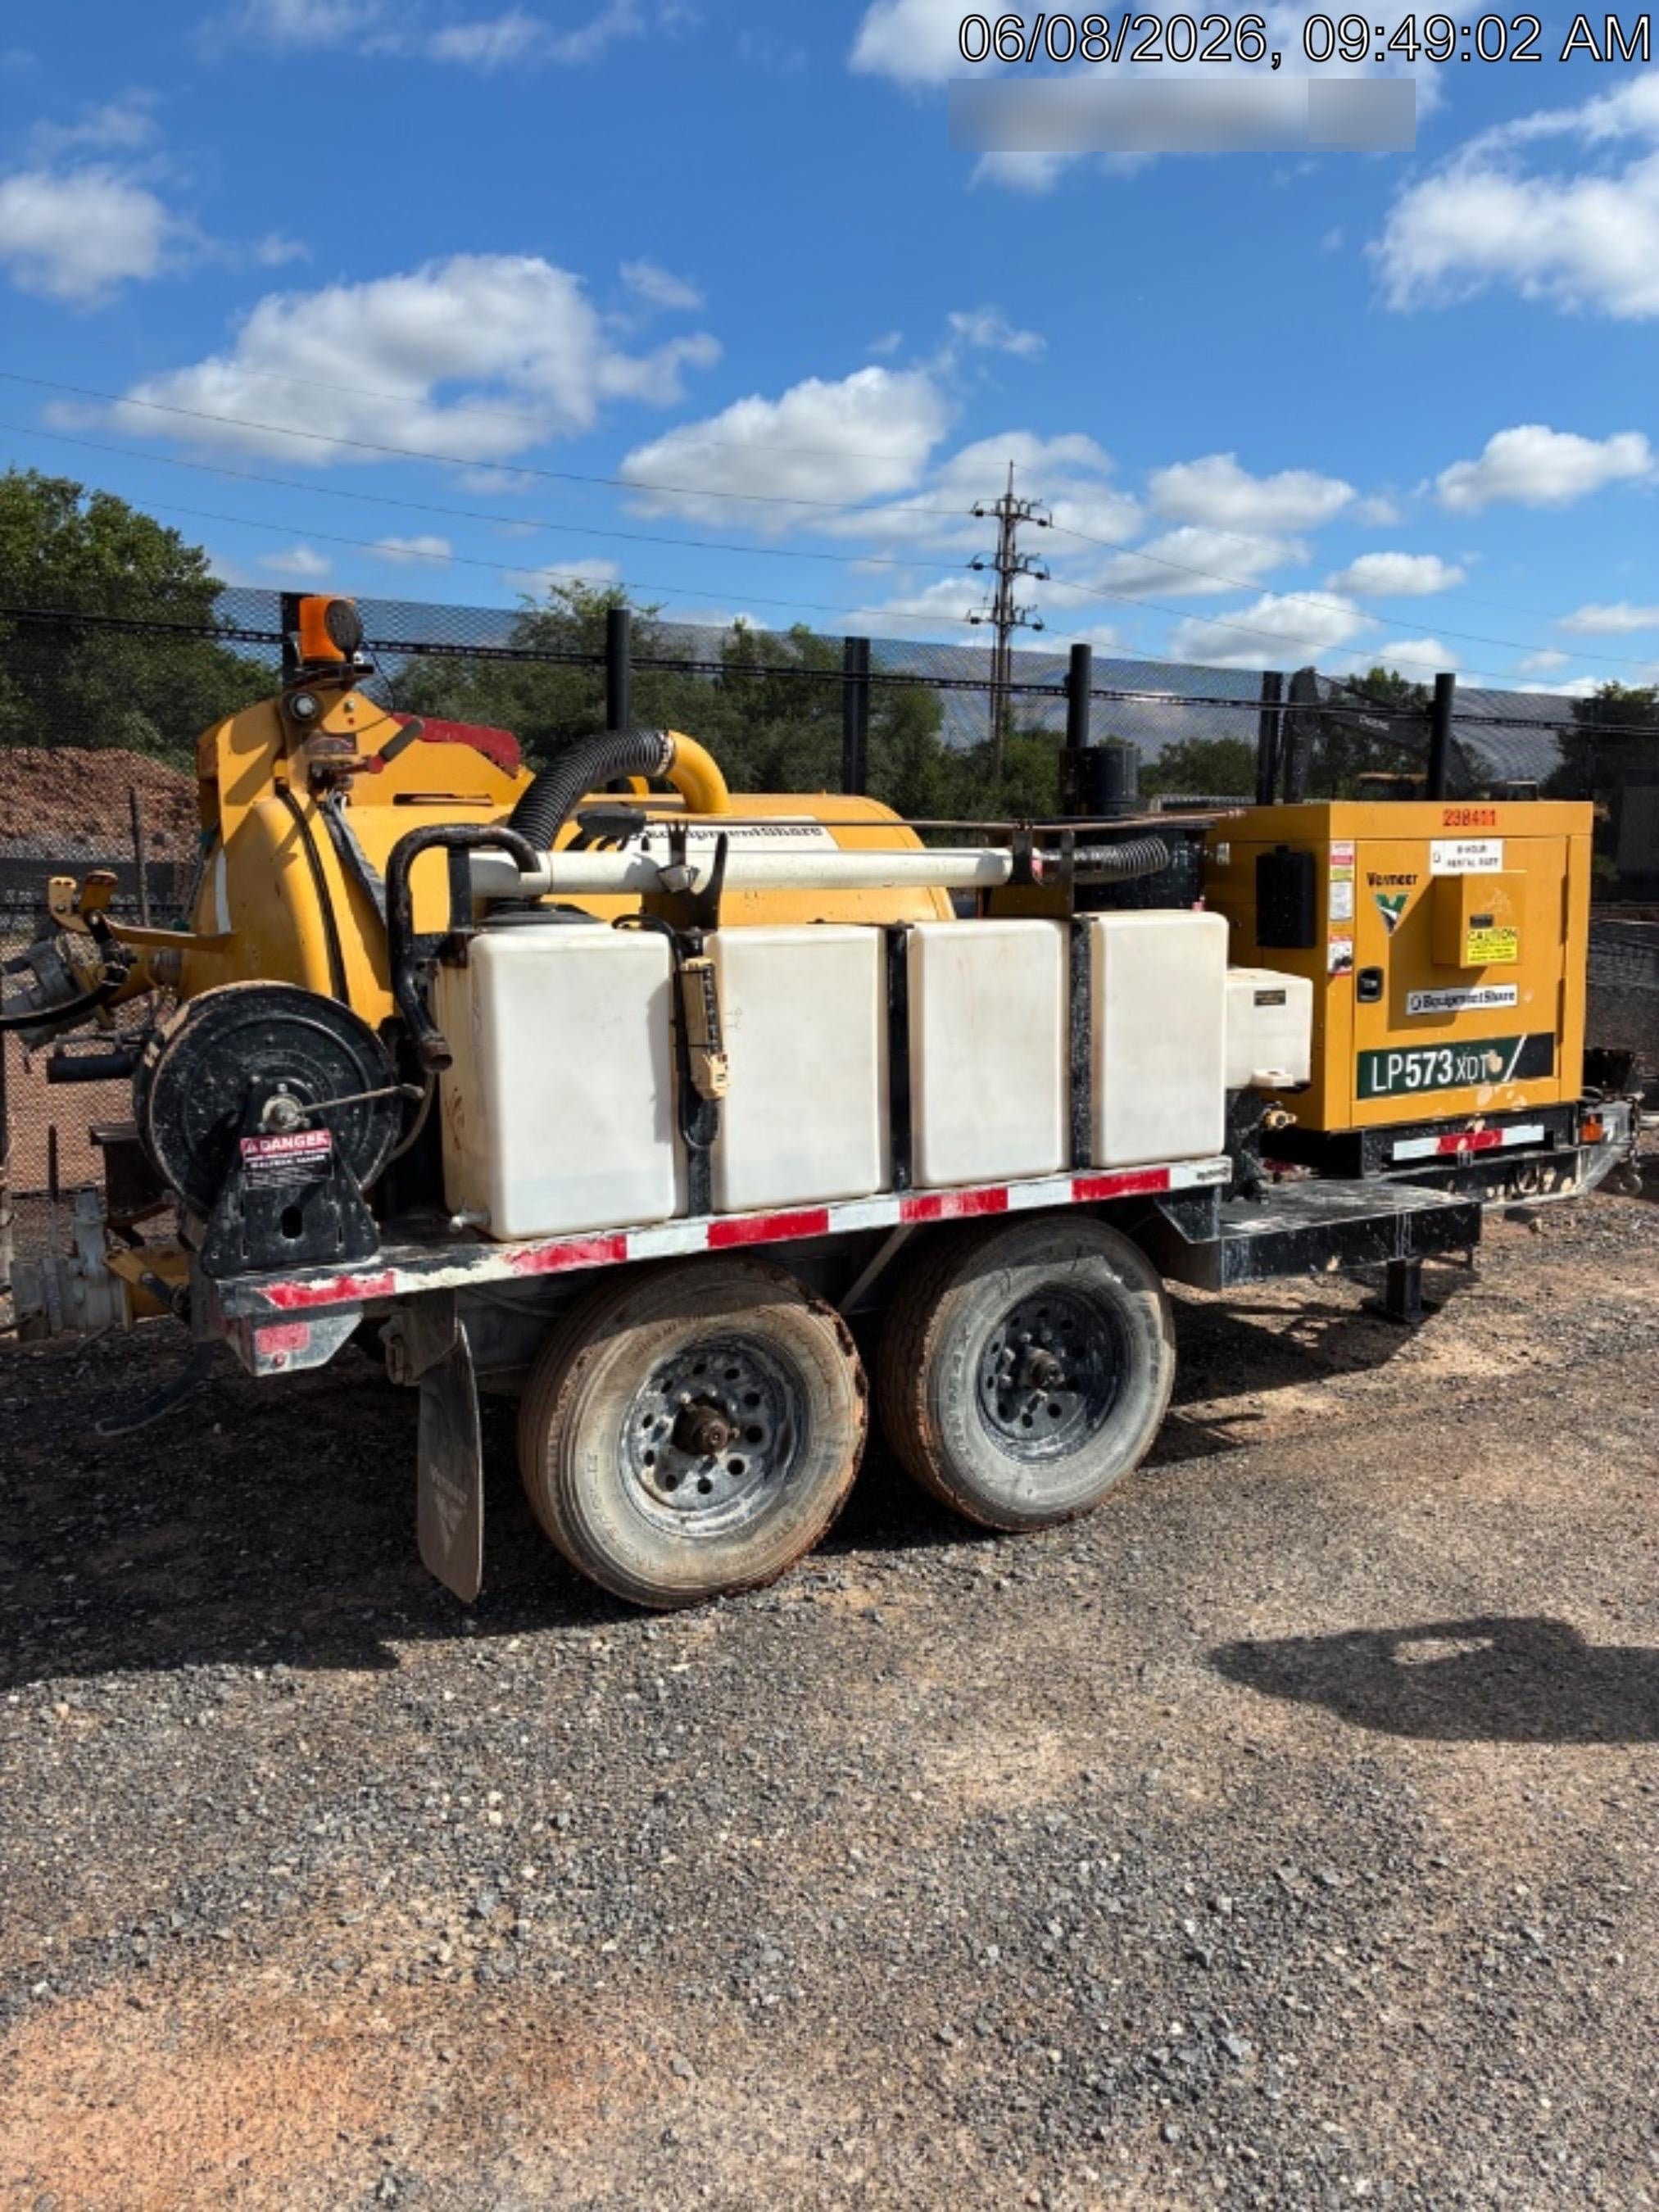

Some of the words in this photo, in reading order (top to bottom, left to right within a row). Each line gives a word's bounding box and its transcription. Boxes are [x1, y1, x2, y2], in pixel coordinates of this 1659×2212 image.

[1367, 872, 1418, 886] Vermeer
[1467, 928, 1517, 942] CAUTION
[1423, 990, 1515, 1008] EquipmentShare
[260, 1131, 328, 1151] DANGER
